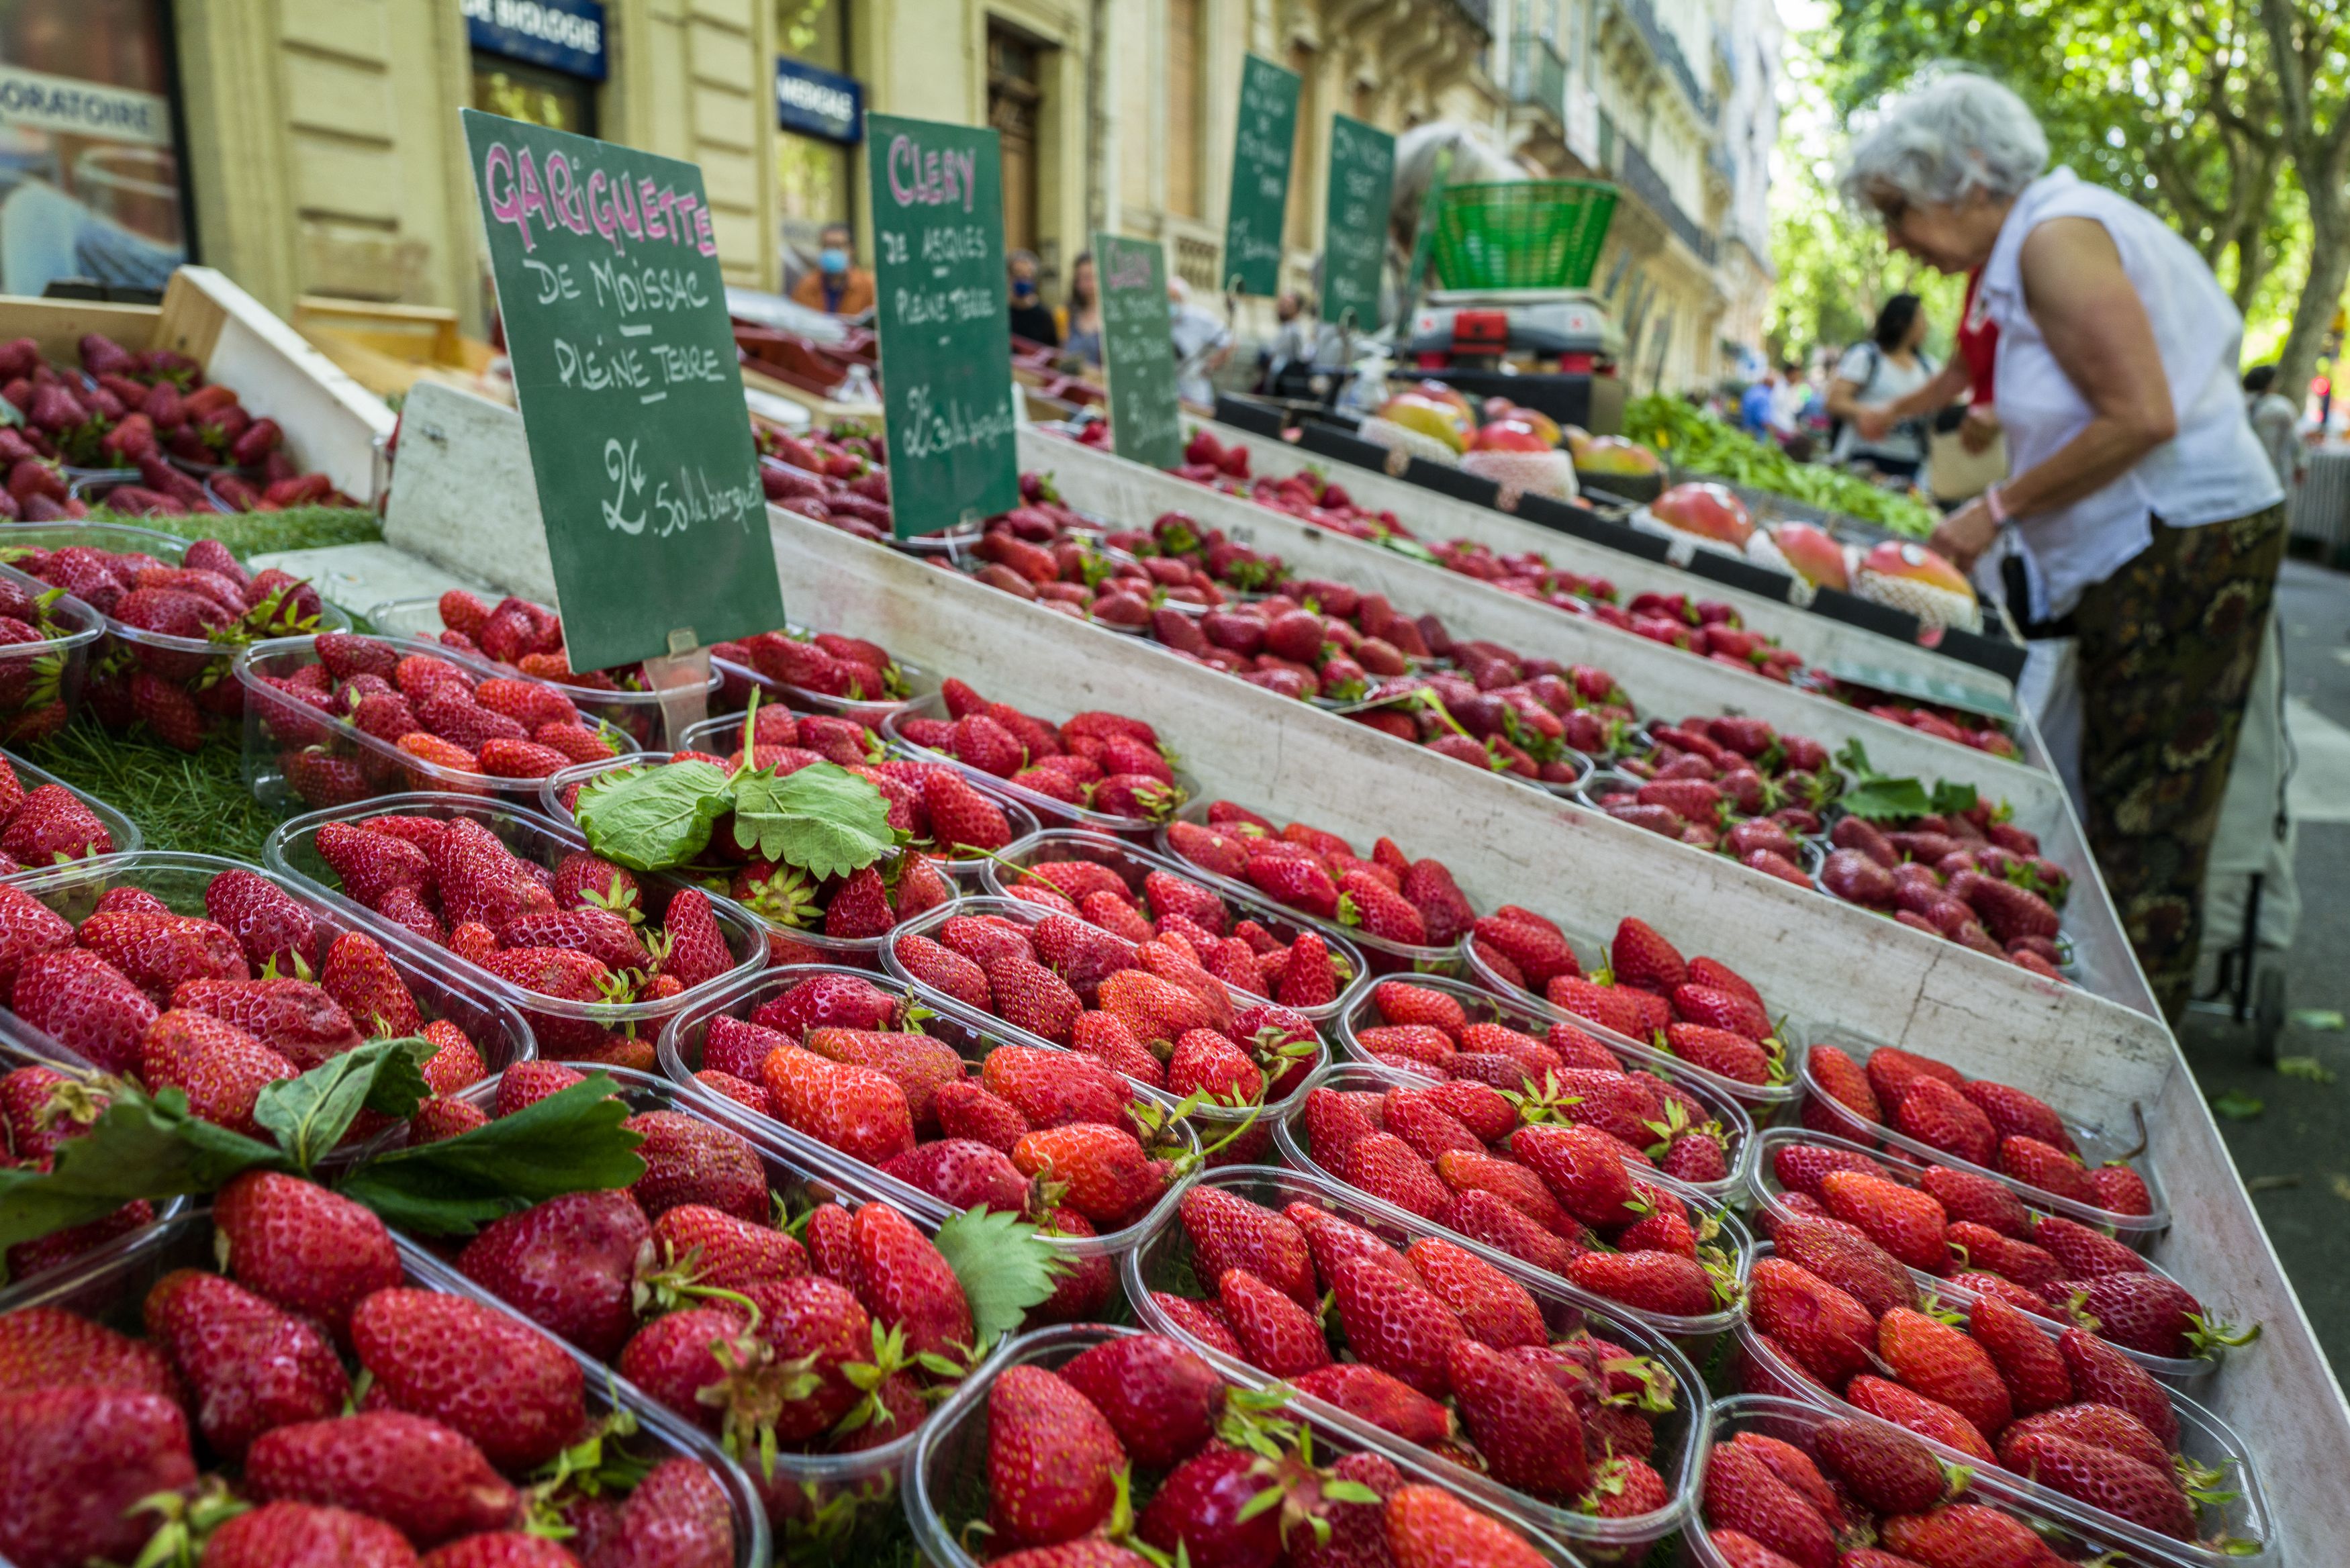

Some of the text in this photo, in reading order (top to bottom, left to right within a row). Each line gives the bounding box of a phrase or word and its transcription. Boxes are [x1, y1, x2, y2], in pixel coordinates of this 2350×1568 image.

[496, 0, 602, 54] BIOLOGIE
[0, 79, 150, 132] ORATOIRE
[522, 258, 581, 304] DE
